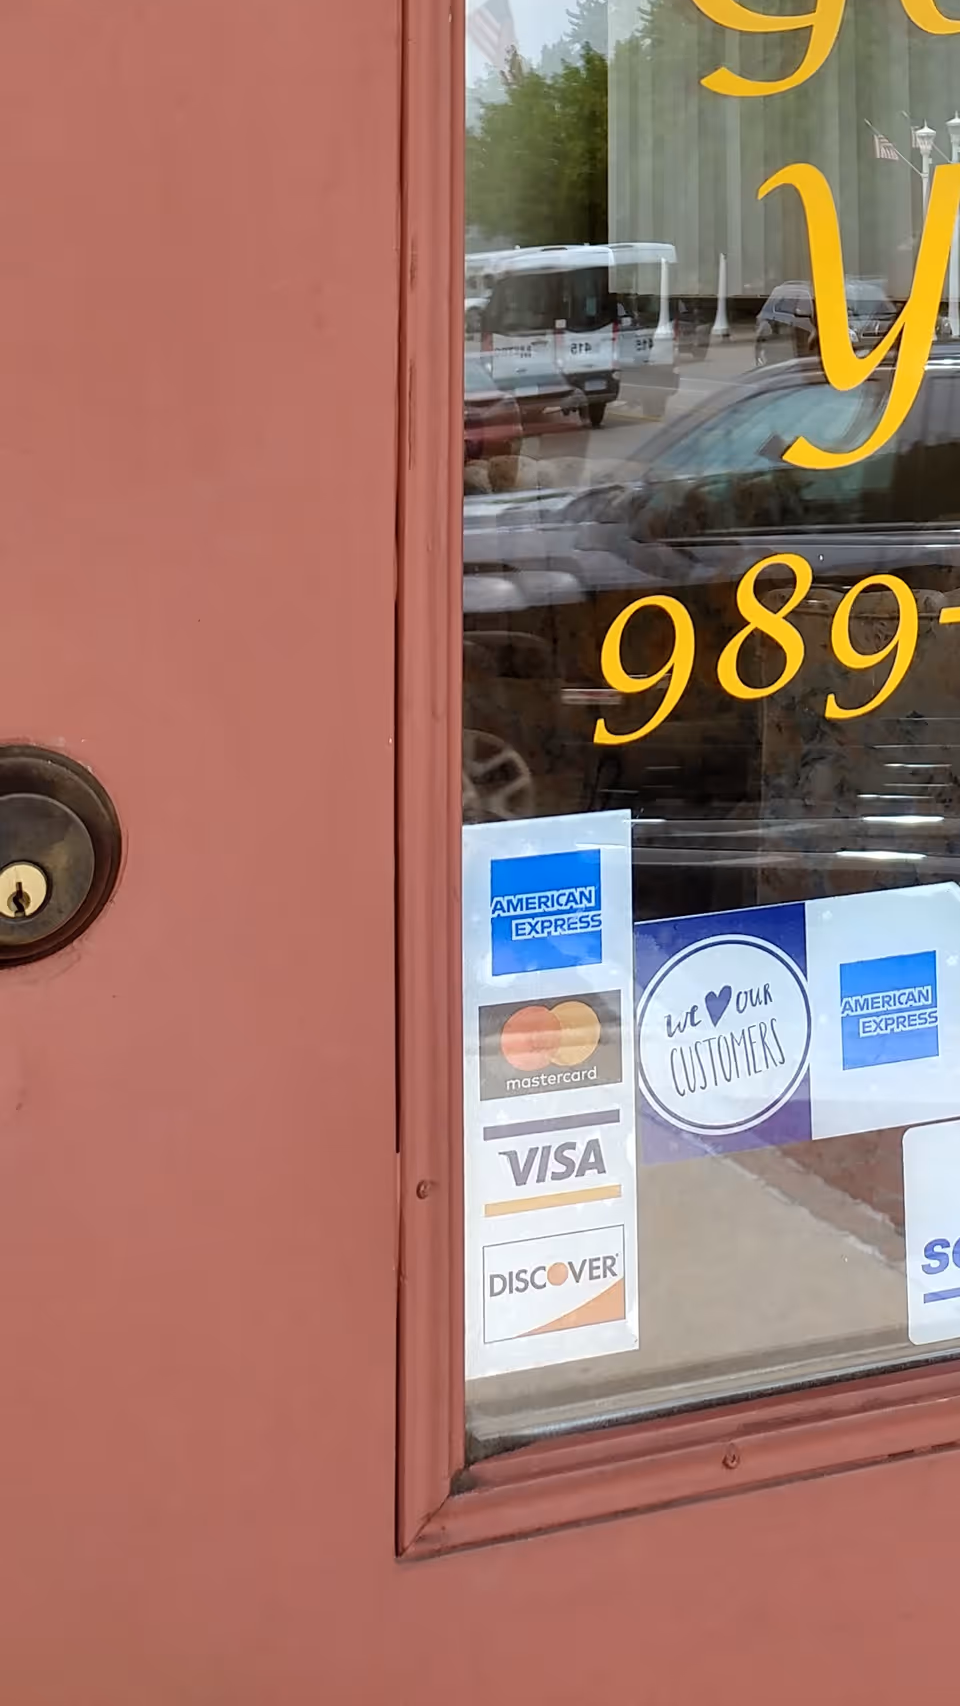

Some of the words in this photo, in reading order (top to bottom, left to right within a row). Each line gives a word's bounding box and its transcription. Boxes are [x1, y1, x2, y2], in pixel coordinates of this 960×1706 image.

[491, 887, 595, 916] AMERICAN
[513, 913, 602, 938] EXPRESS
[841, 986, 932, 1016] AMERICAN
[860, 1009, 940, 1037] EXPRESS
[669, 1017, 786, 1097] CUSTOMERS
[506, 1066, 598, 1090] mastercard
[498, 1138, 606, 1186] VISA
[489, 1254, 619, 1297] DISCOVER
